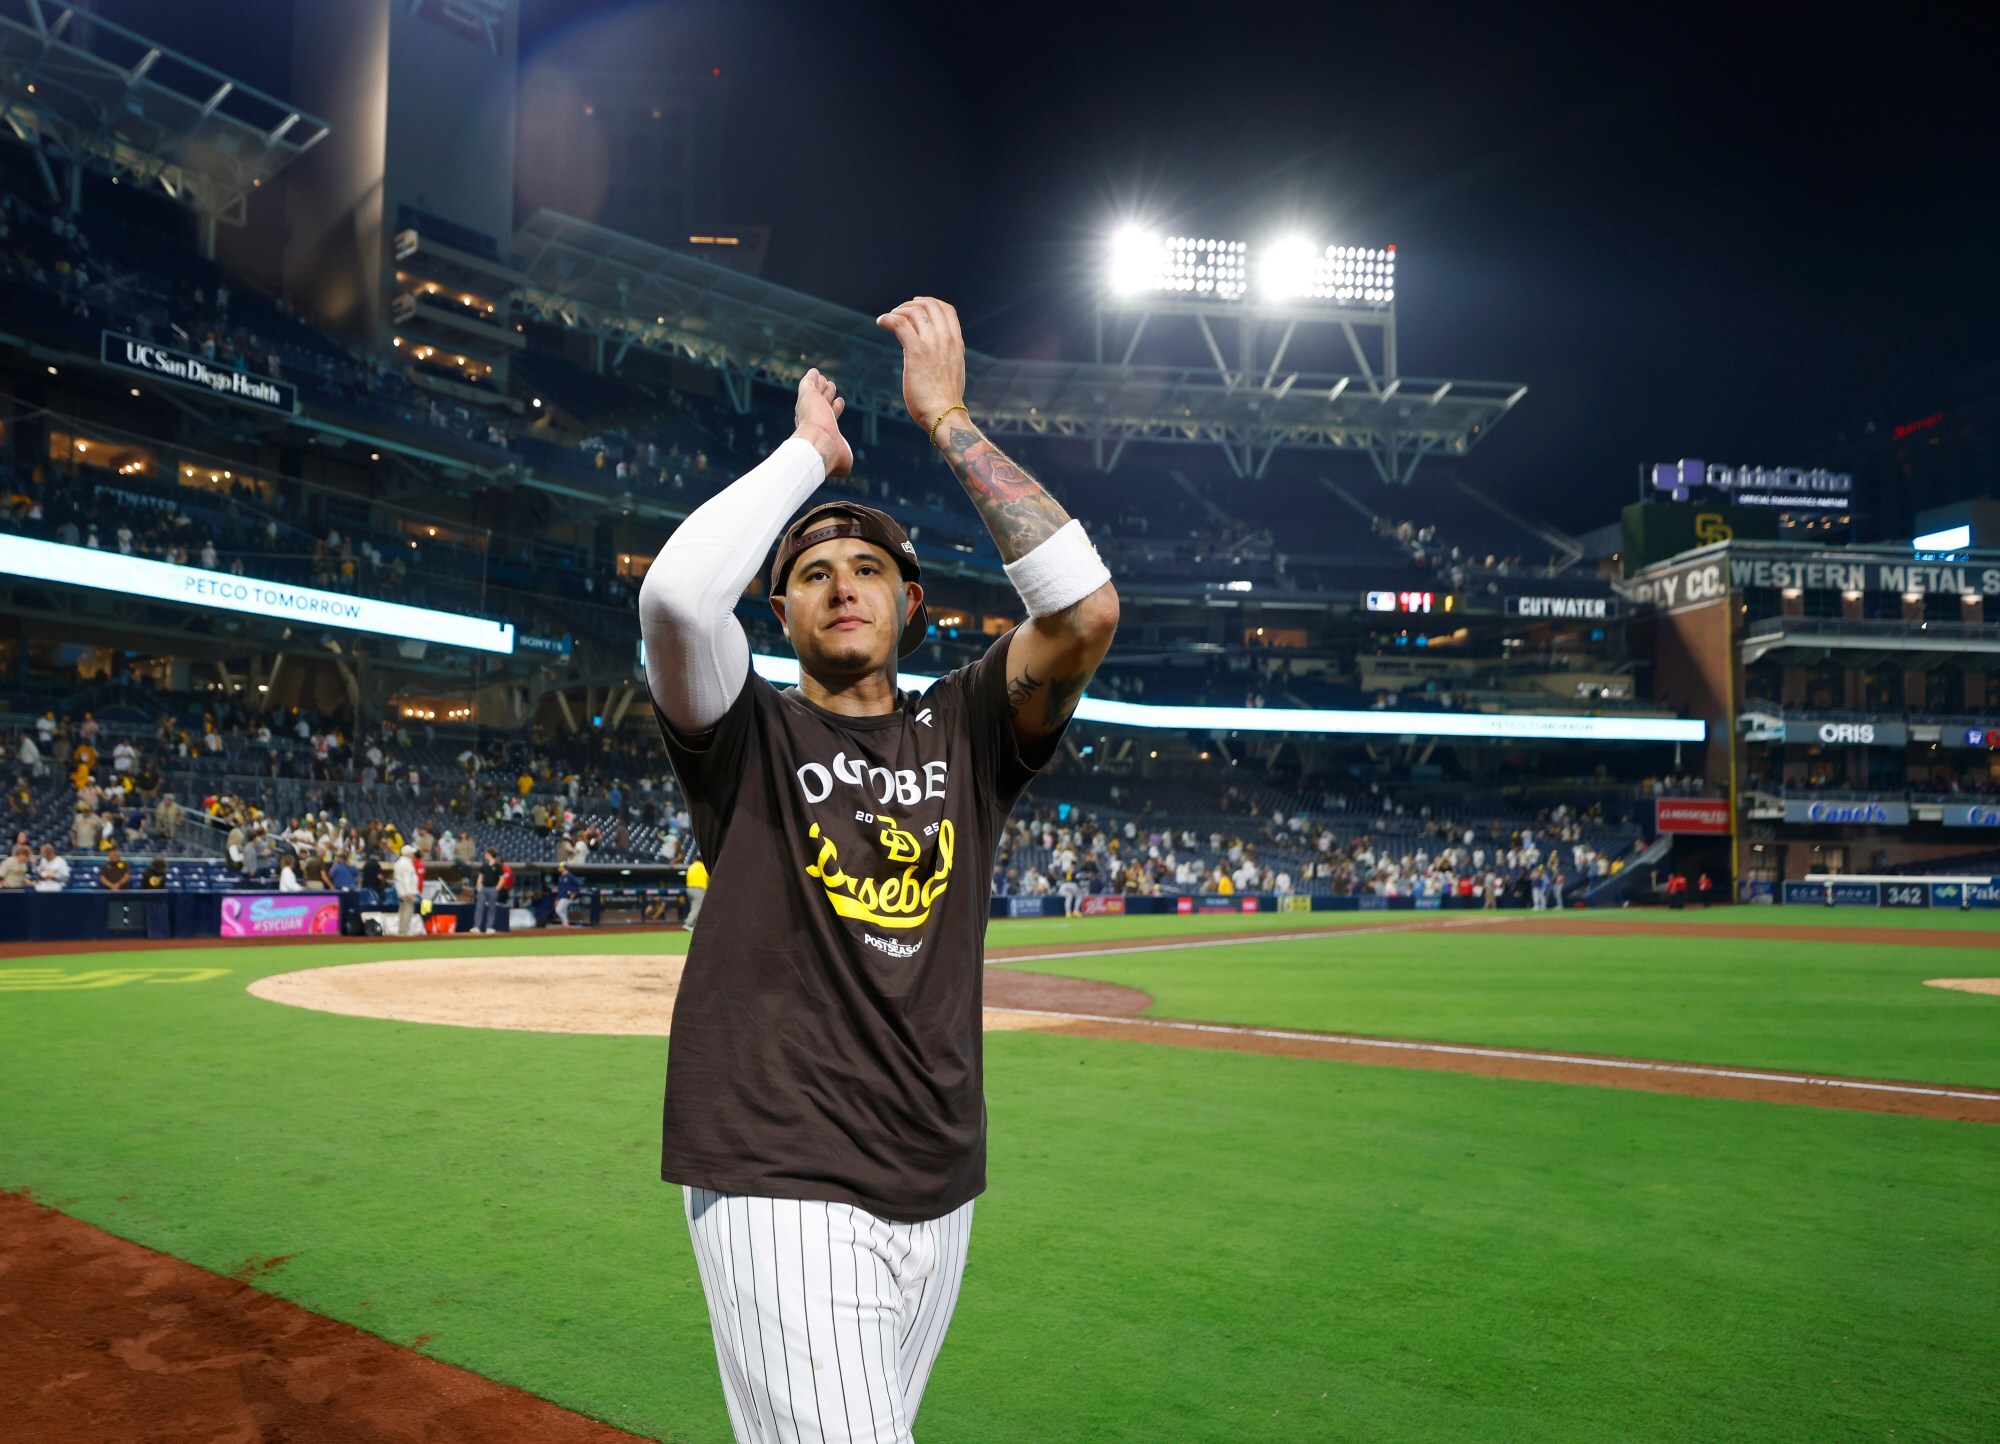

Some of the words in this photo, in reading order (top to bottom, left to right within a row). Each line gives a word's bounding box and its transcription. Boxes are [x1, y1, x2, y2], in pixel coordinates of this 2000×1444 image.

[126, 341, 153, 369] UC
[154, 350, 187, 378] San
[187, 359, 232, 391] Diego
[232, 372, 281, 404] Health
[1685, 565, 1726, 601] CO.
[1731, 559, 1866, 590] WESTERN
[1880, 565, 1975, 594] METAL
[185, 576, 248, 600] PETCO
[254, 588, 361, 618] TOMORROW
[1518, 597, 1606, 618] CUTWATER
[1819, 723, 1875, 744] ORIS
[796, 751, 949, 806] OCTOBE
[855, 810, 874, 824] 20
[923, 822, 940, 837] 25
[1887, 886, 1922, 904] 342
[864, 933, 924, 955] POSTSEASON
